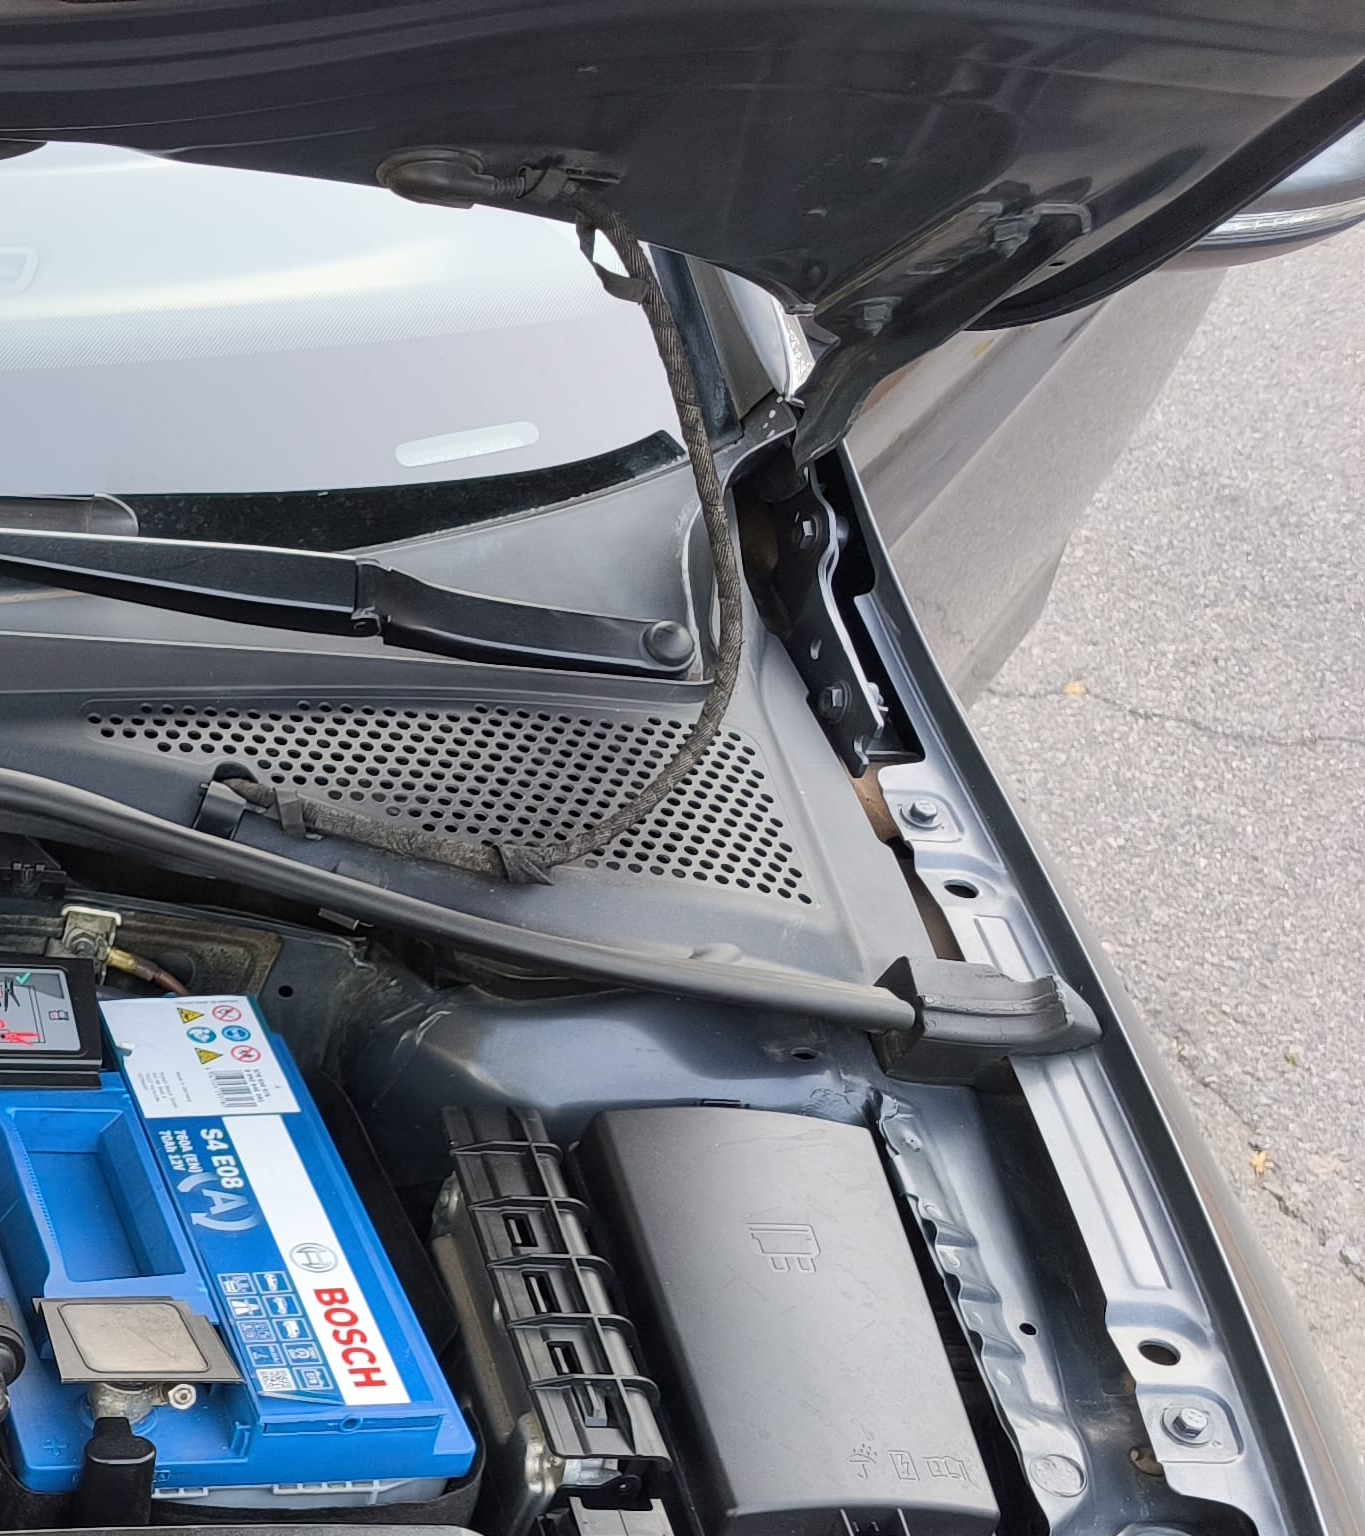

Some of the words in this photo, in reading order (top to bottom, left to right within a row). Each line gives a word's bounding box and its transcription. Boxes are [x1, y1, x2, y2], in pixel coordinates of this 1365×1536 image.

[158, 1130, 179, 1154] 70Ah
[174, 1130, 192, 1153] 760A
[183, 1153, 204, 1173] (EN)
[200, 1128, 228, 1151] S4
[167, 1154, 186, 1172] 12V
[211, 1154, 244, 1189] E08
[313, 1288, 388, 1387] BOSCH
